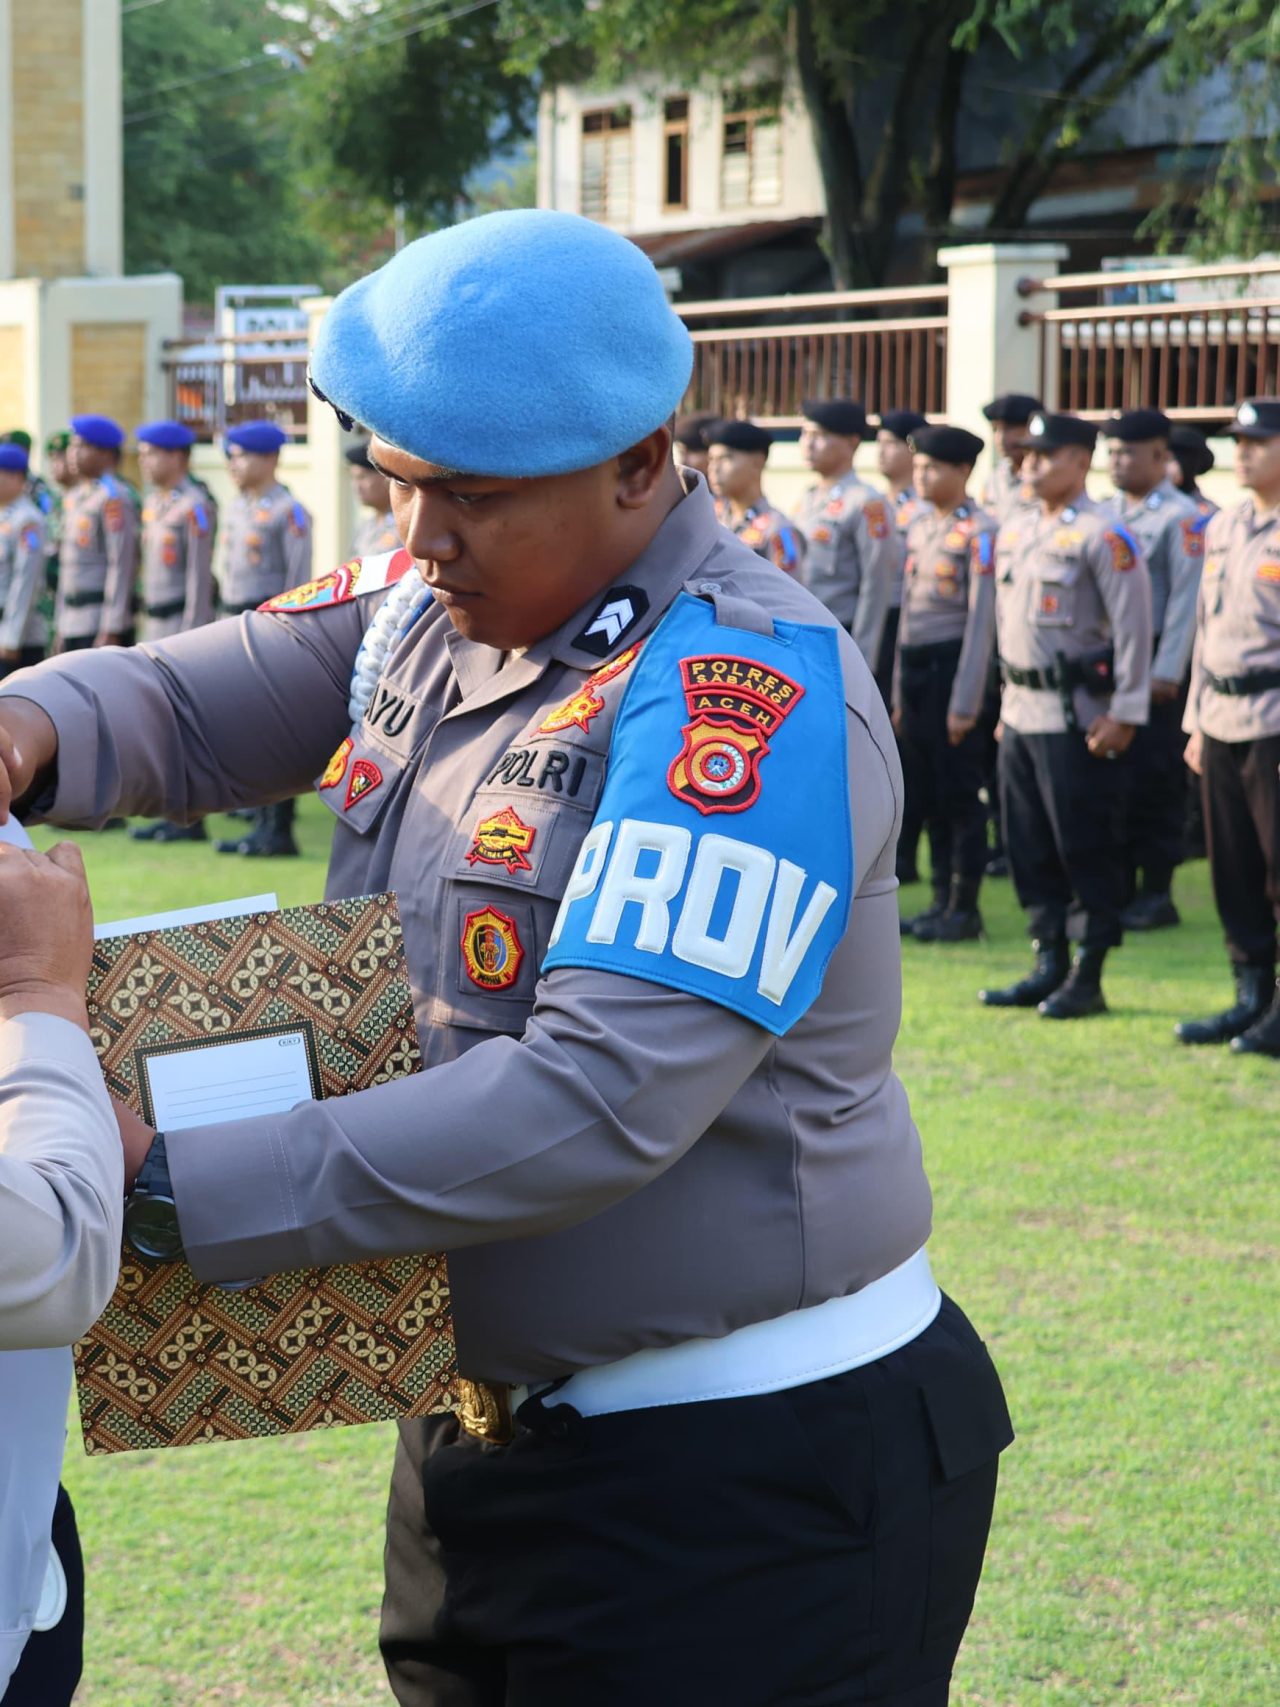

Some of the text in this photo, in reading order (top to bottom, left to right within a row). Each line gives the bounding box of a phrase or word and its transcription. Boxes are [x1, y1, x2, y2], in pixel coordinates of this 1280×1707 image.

[691, 661, 793, 698] POLRES
[696, 673, 783, 704] SABANG
[698, 696, 770, 727] ACEH
[487, 749, 587, 797] POLRI
[548, 818, 838, 1006] PROV
